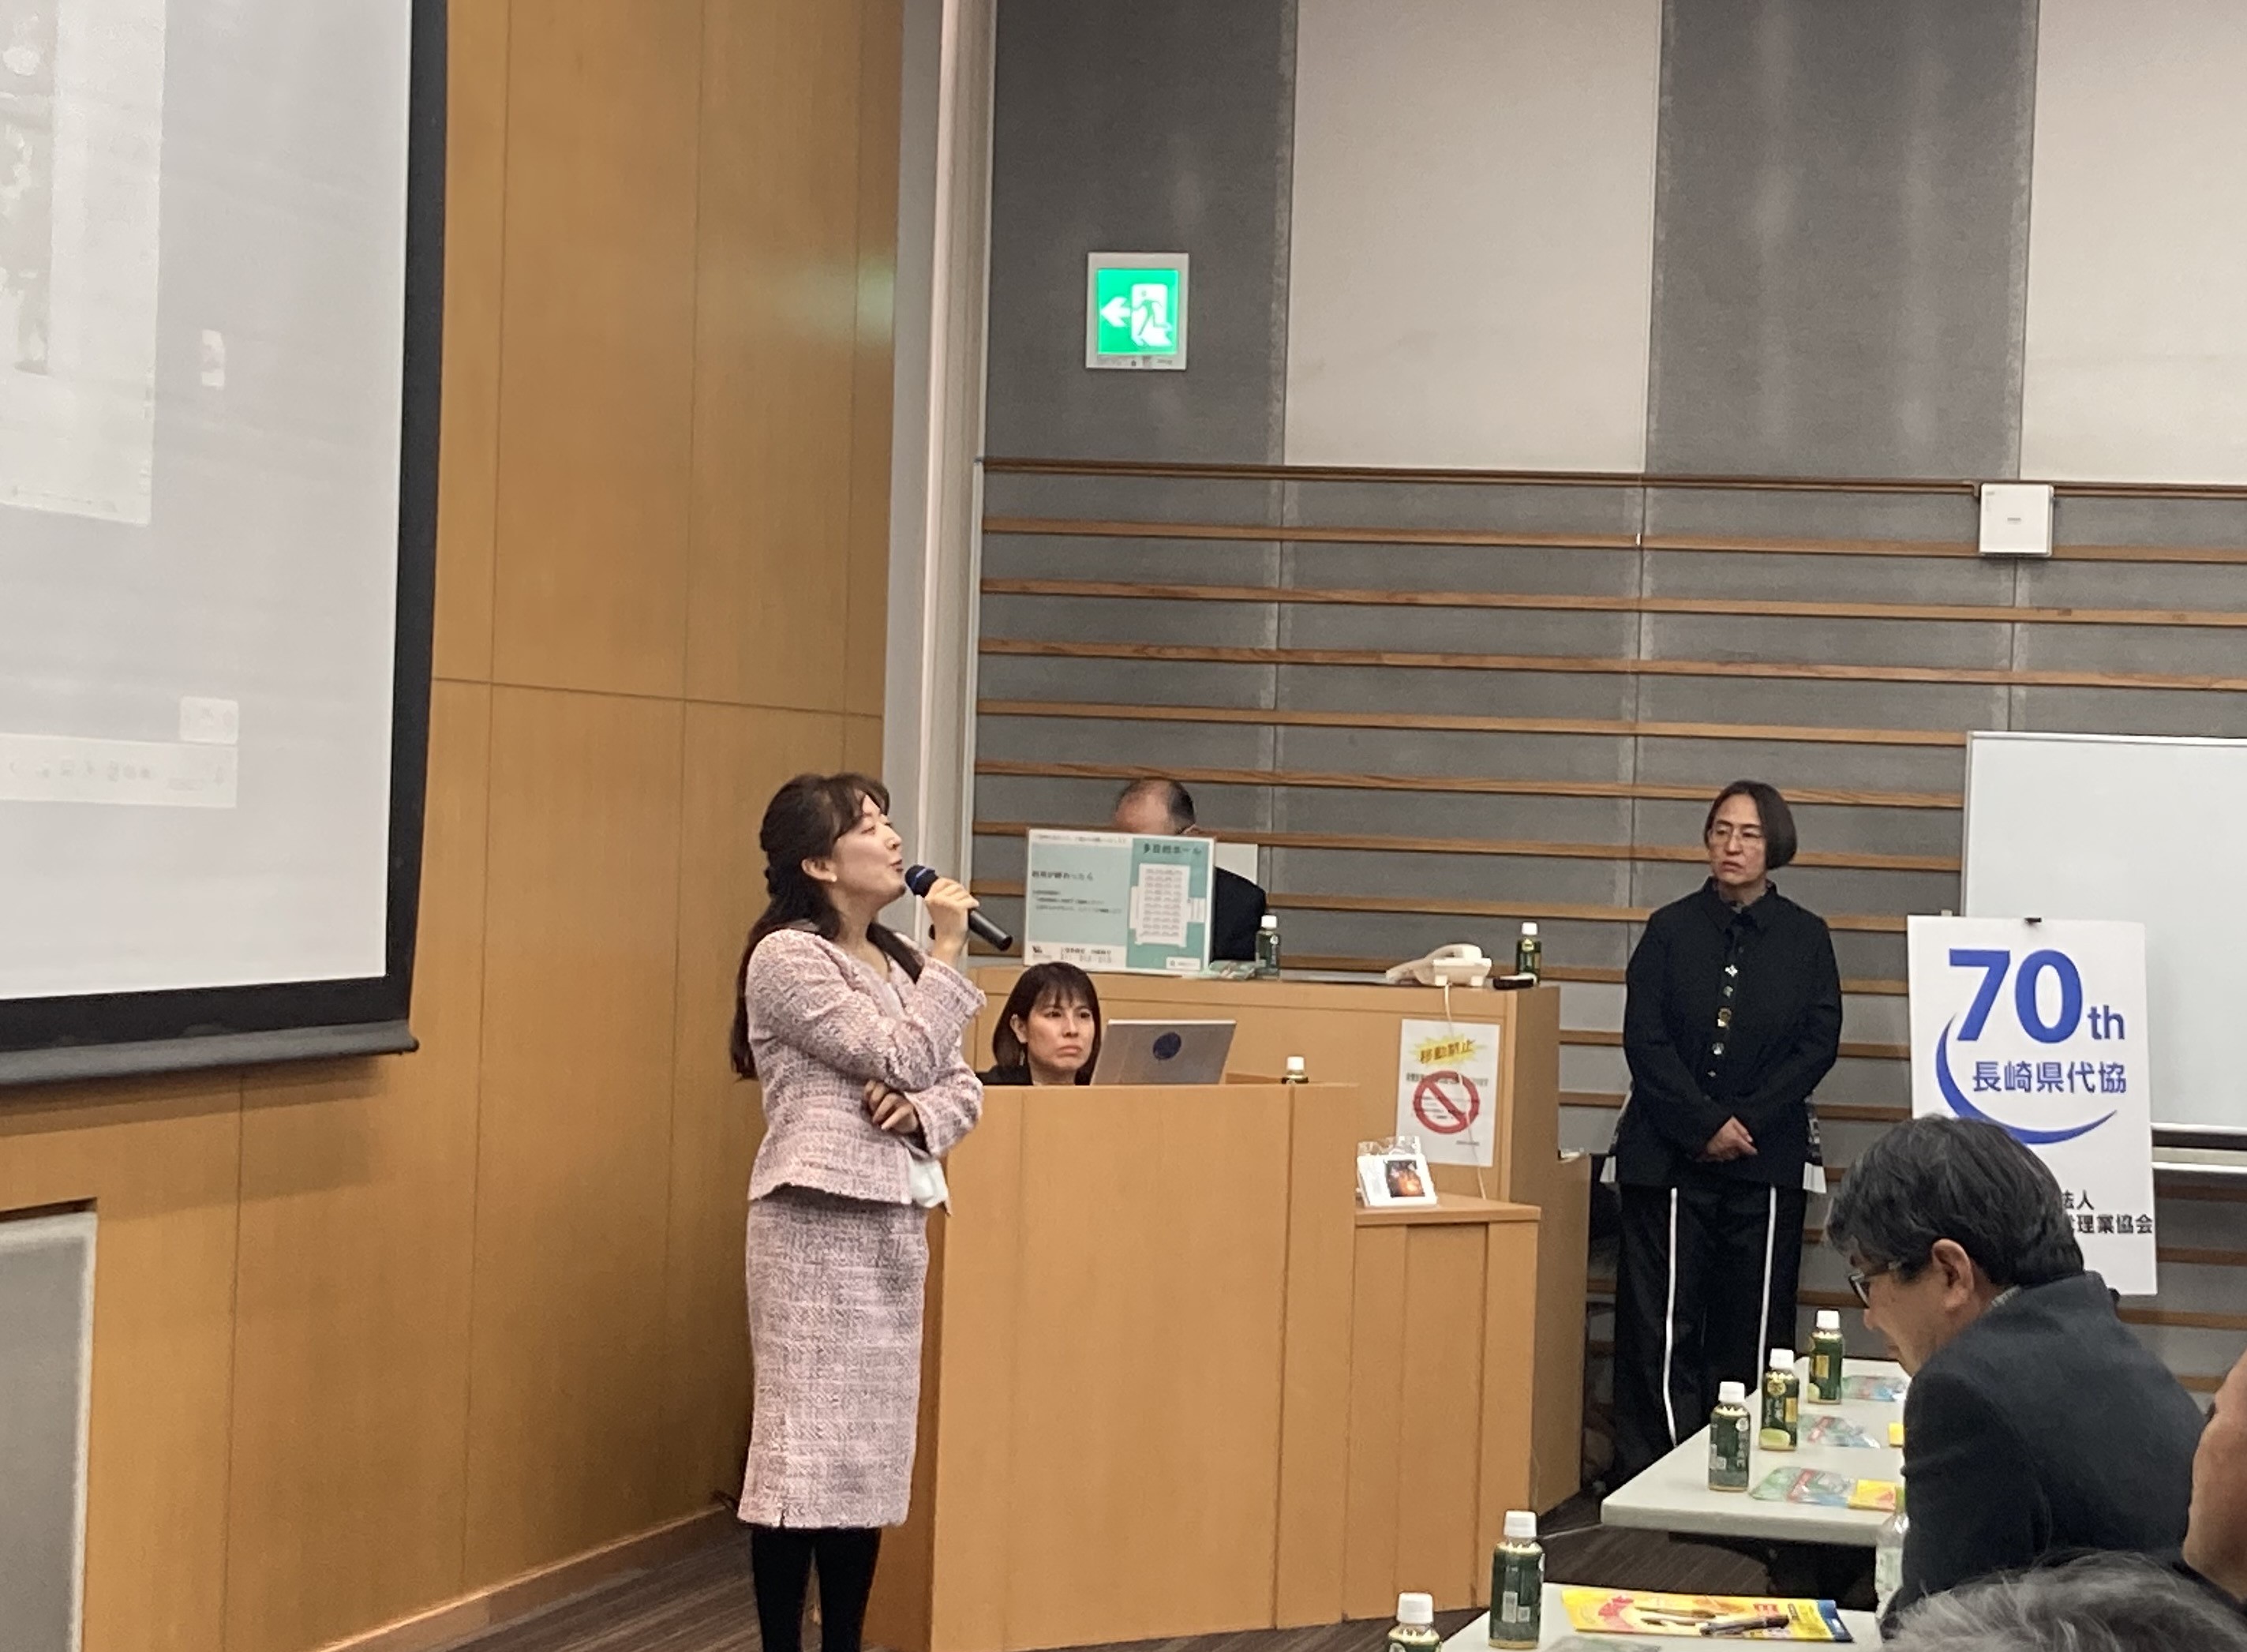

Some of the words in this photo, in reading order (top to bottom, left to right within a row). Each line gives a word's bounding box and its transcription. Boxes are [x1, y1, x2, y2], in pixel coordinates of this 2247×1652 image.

[1949, 948, 2125, 1043] 70th
[1973, 1061, 2126, 1093] 長崎県代協
[2069, 1214, 2152, 1234] 理業協会
